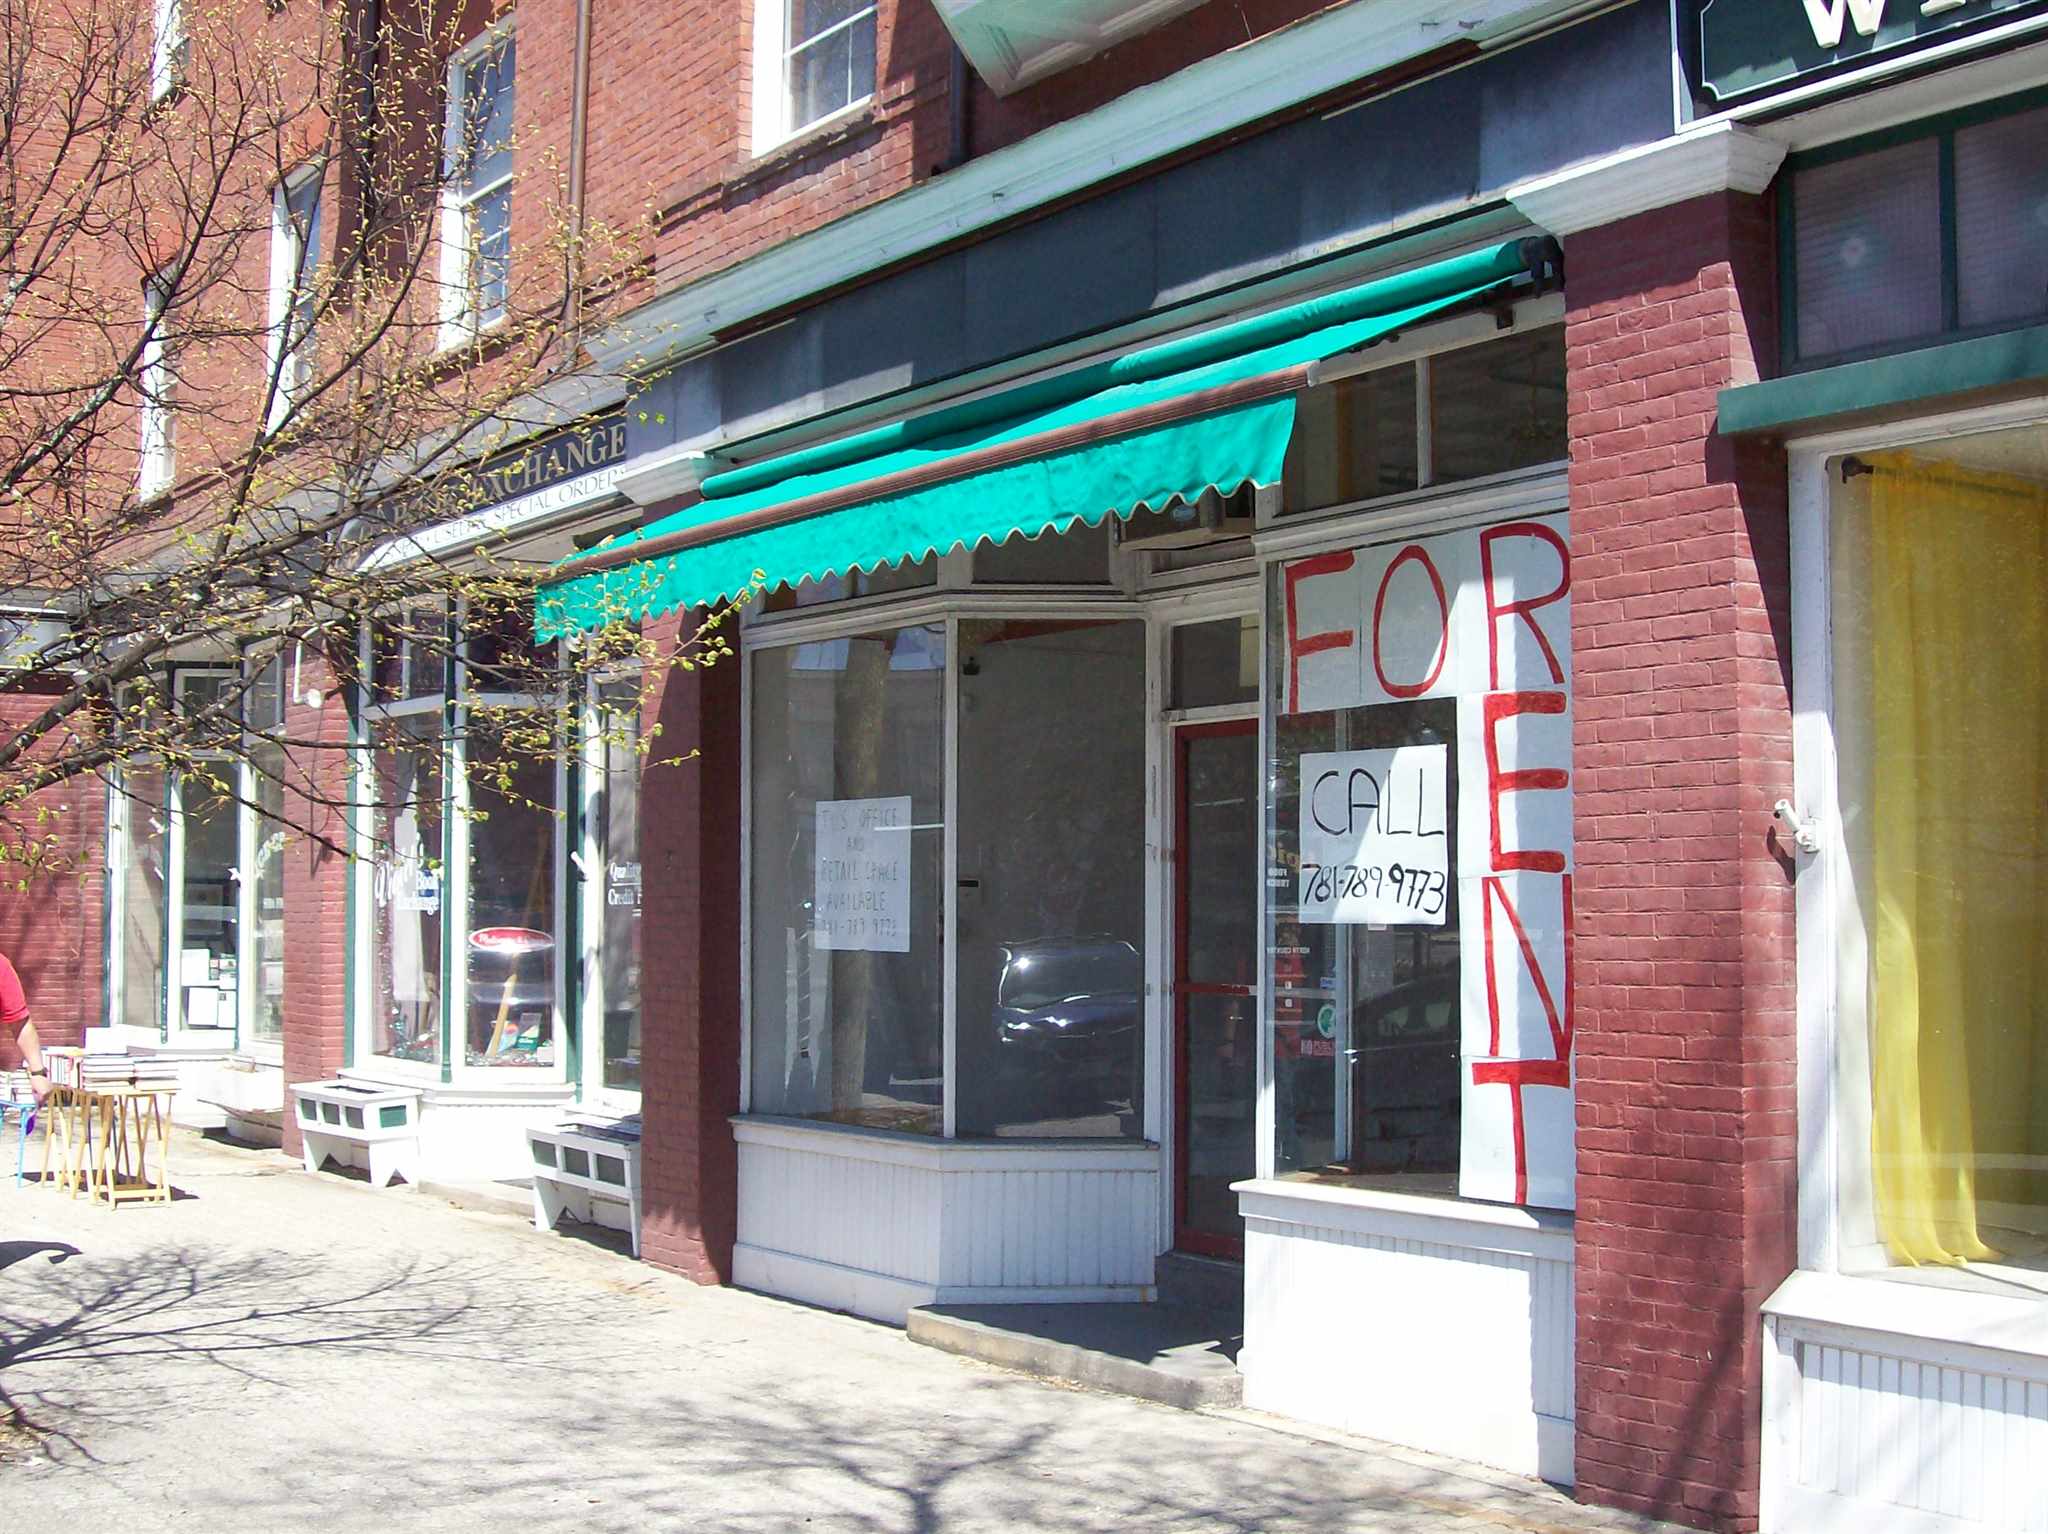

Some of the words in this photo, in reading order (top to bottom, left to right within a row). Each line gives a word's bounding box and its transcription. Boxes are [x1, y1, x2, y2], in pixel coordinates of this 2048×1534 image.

[472, 421, 627, 505] EXCHANGE
[494, 491, 553, 522] SPECIAL
[1283, 521, 1571, 714] FOR
[1311, 767, 1445, 837] CALL
